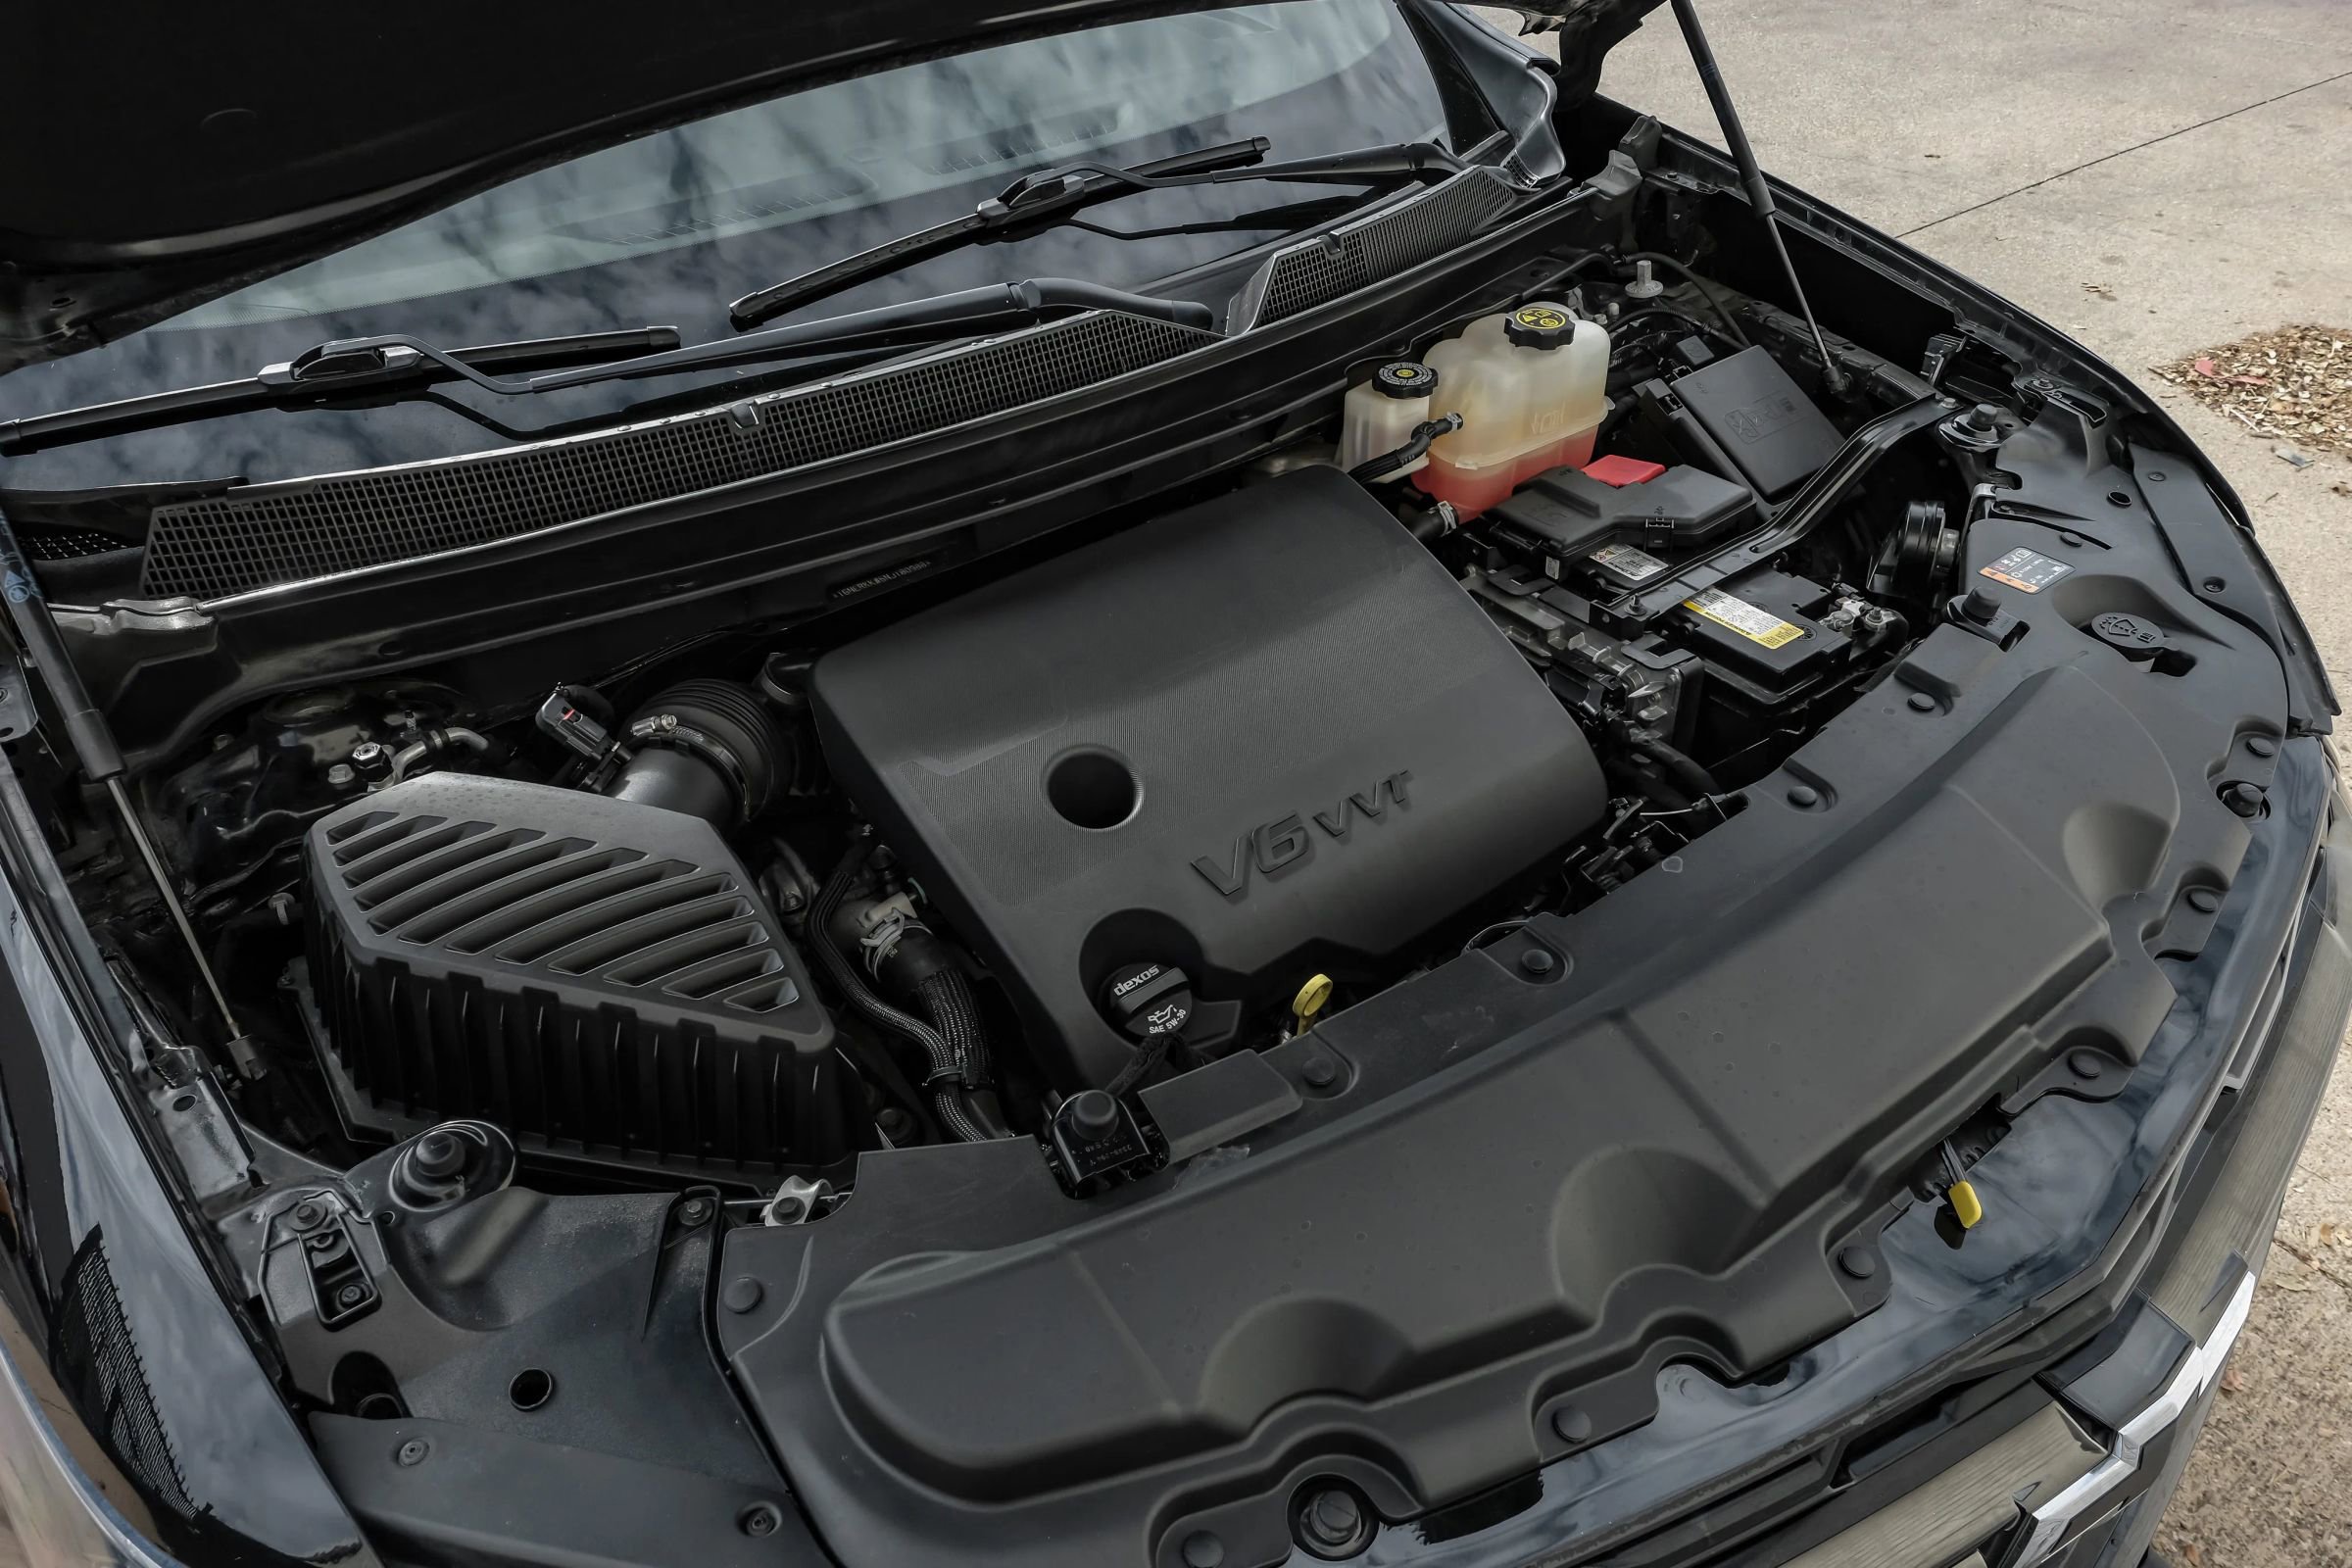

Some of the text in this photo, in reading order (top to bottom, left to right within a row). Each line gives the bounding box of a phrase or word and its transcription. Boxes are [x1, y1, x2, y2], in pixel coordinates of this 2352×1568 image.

[1191, 768, 1412, 897] V6 VVT
[1113, 964, 1160, 996] dexos
[1149, 1008, 1187, 1034] SAE 5W-30
